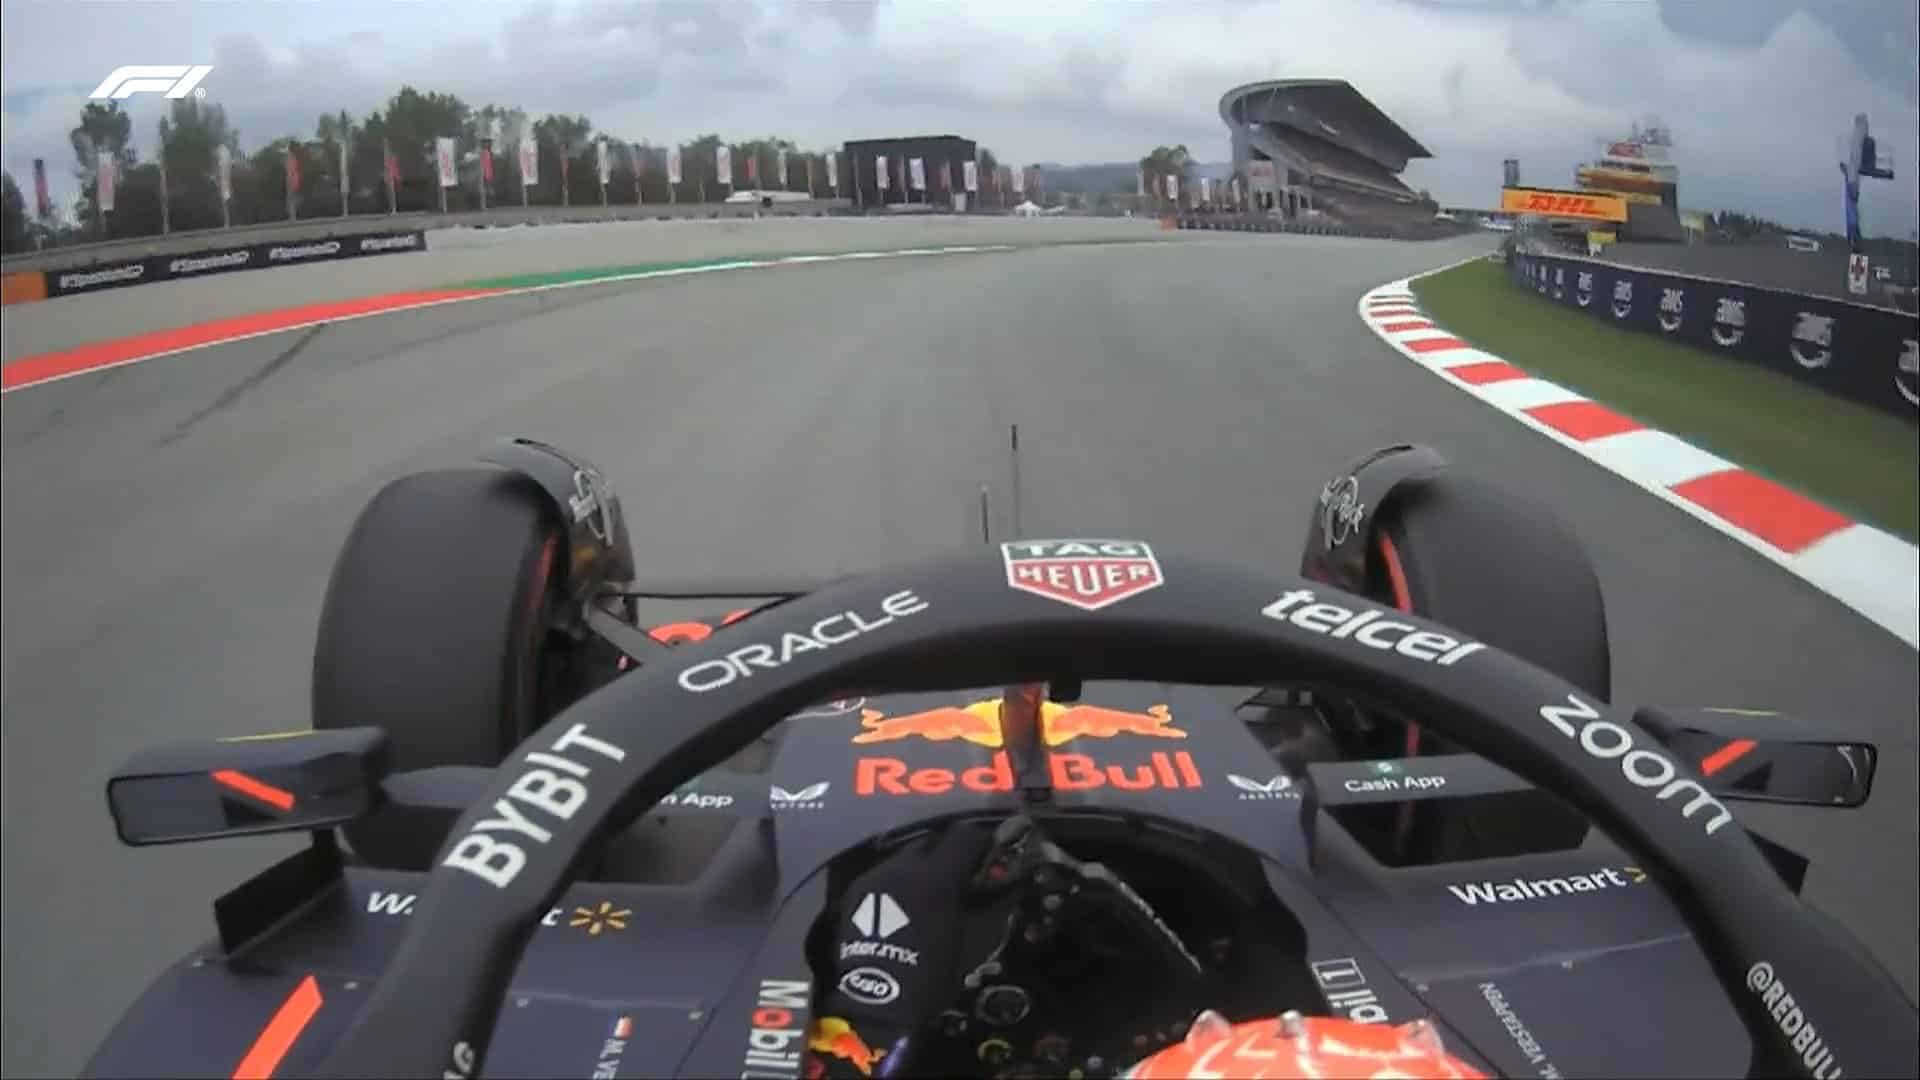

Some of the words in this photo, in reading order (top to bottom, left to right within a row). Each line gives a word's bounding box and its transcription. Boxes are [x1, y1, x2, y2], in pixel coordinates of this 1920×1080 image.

[1010, 542, 1138, 556] TAG
[1017, 562, 1152, 596] HEUER
[677, 589, 930, 692] ORACLE
[1260, 589, 1490, 666] telcel
[855, 750, 1015, 796] Red
[1050, 751, 1204, 791] Bull
[1344, 776, 1399, 792] Cash
[1404, 774, 1447, 789] App
[1538, 693, 1734, 836] zoom
[442, 723, 627, 889] BYBIT
[681, 792, 735, 809] App
[1447, 867, 1627, 905] Walmart
[743, 978, 809, 1069] Mobil
[1327, 988, 1389, 1024] bil
